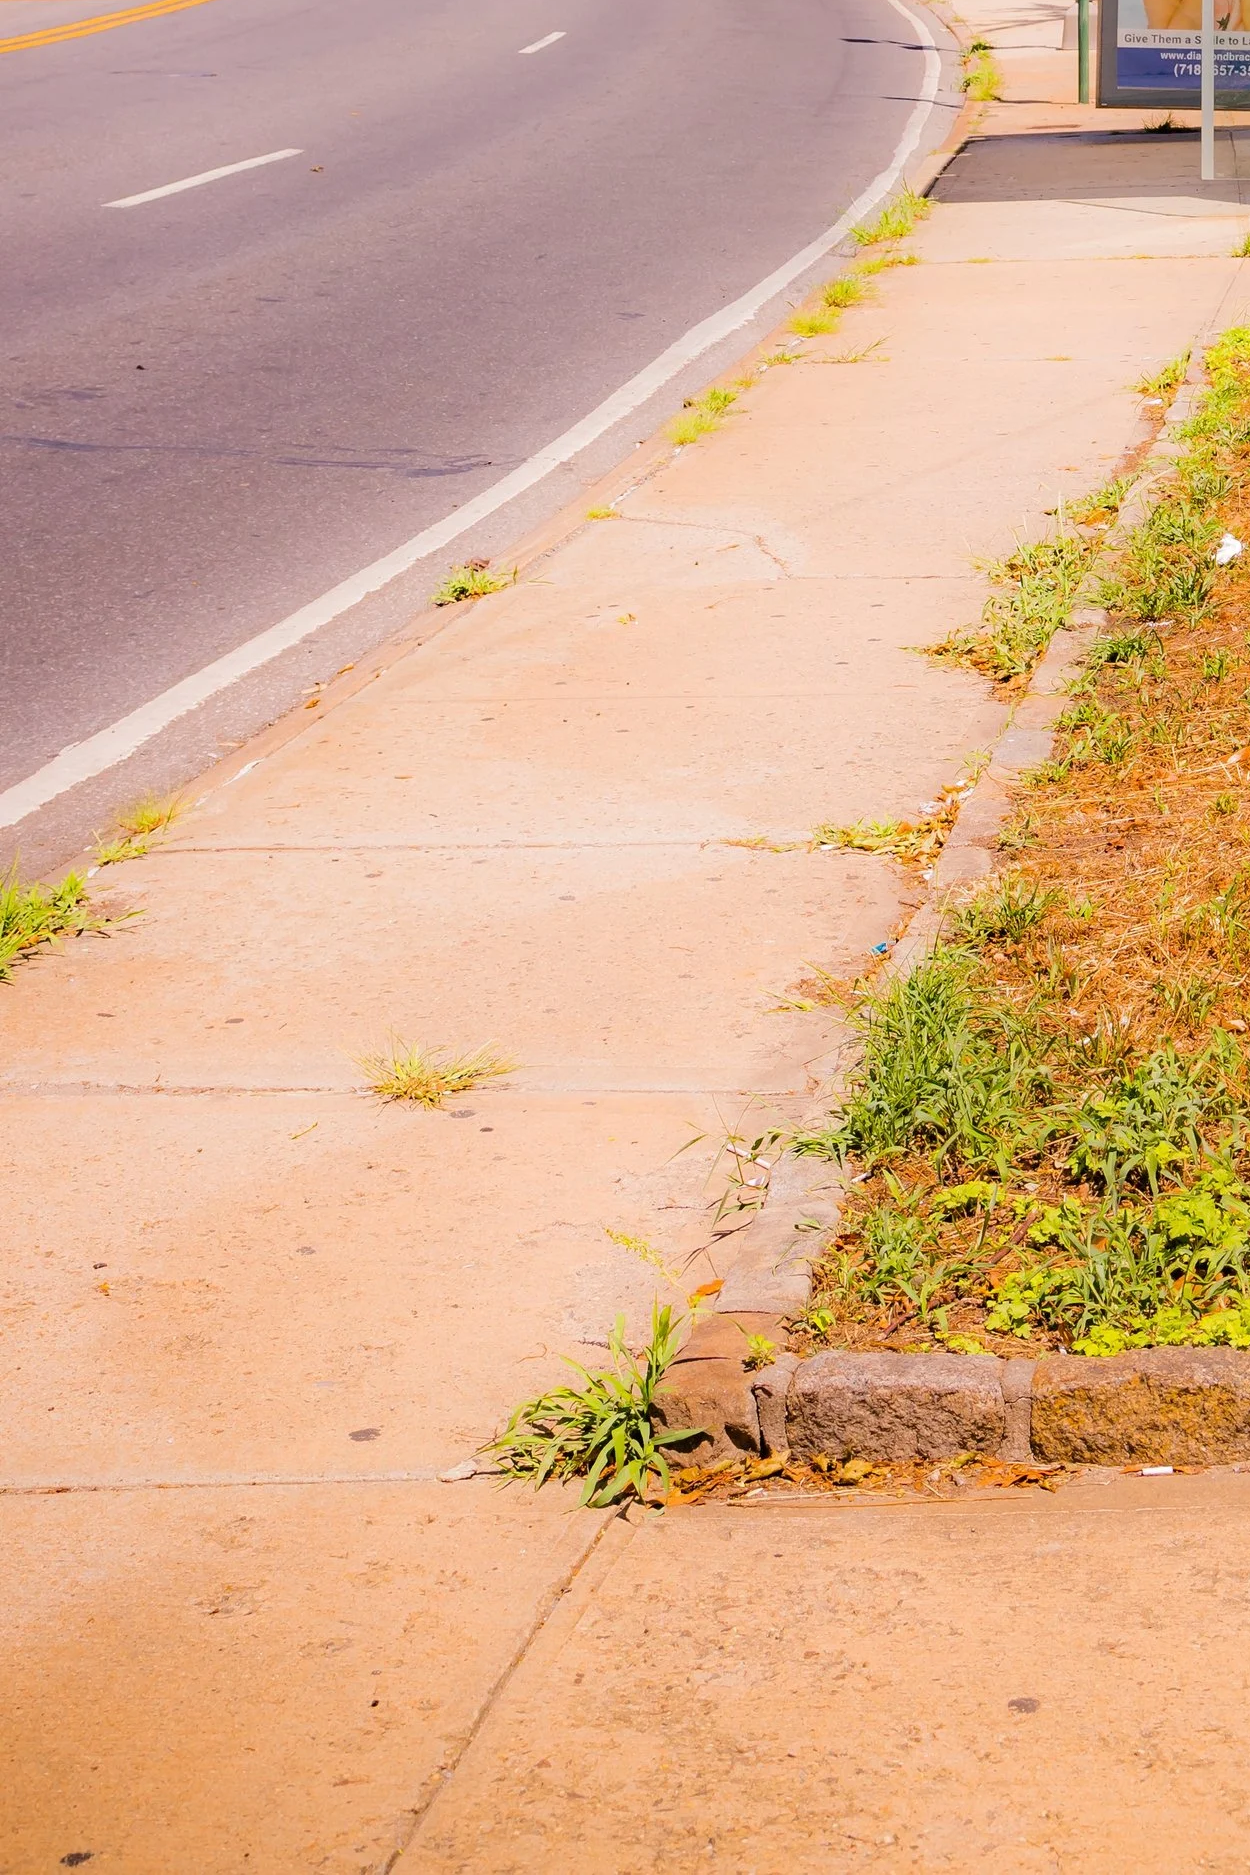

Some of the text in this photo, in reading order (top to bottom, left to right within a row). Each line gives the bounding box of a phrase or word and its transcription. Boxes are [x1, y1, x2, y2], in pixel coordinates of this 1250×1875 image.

[1124, 34, 1148, 43] Give
[1151, 34, 1182, 44] Them
[1185, 36, 1191, 44] a
[1194, 35, 1225, 45] Sle
[1228, 36, 1239, 45] to
[1173, 63, 1202, 77] (718
